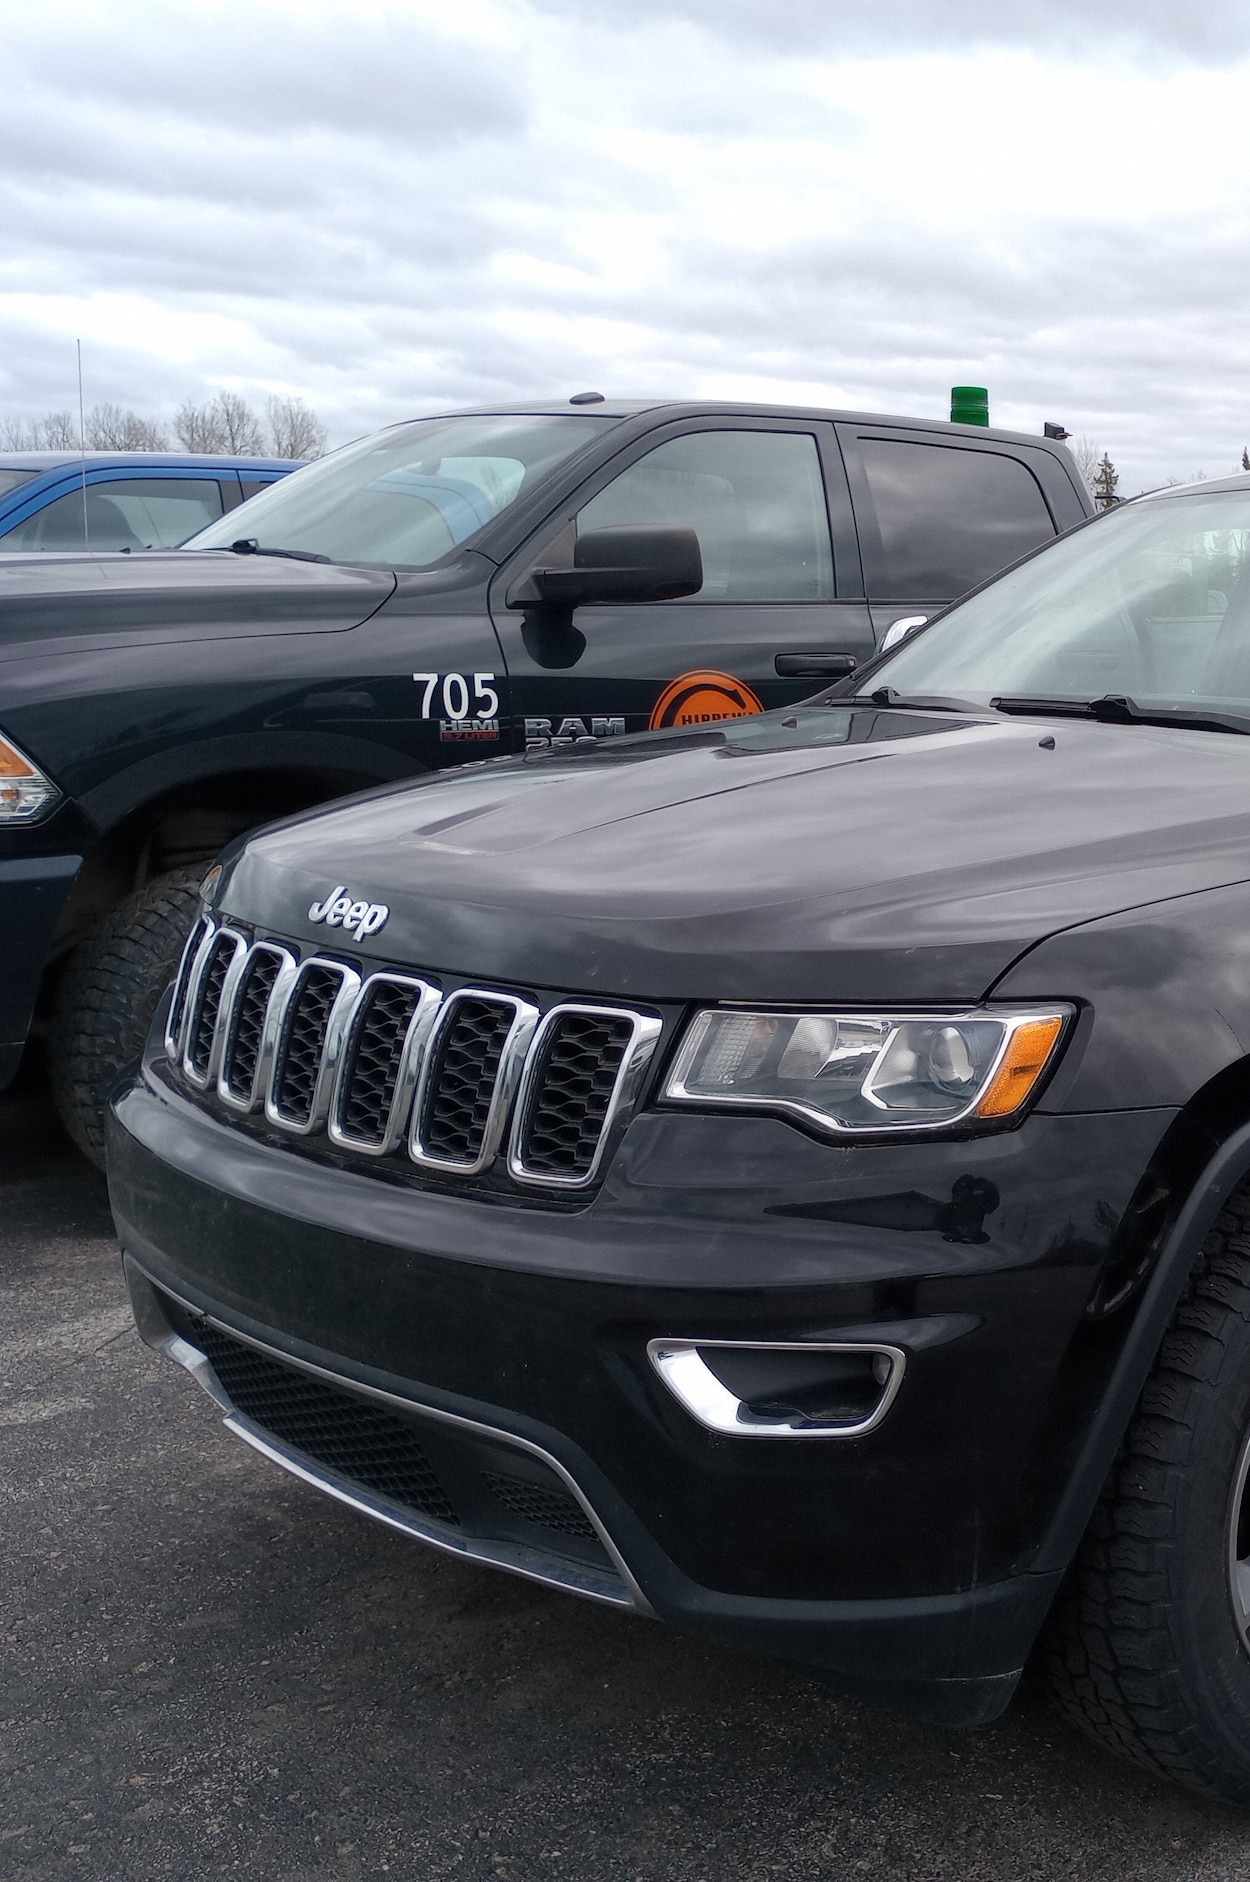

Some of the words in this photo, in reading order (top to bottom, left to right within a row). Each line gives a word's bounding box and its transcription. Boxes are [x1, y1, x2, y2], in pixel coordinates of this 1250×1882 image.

[412, 673, 499, 720] 705
[440, 720, 499, 731] HEMI
[524, 717, 626, 736] RAM
[308, 886, 390, 943] Jeep
